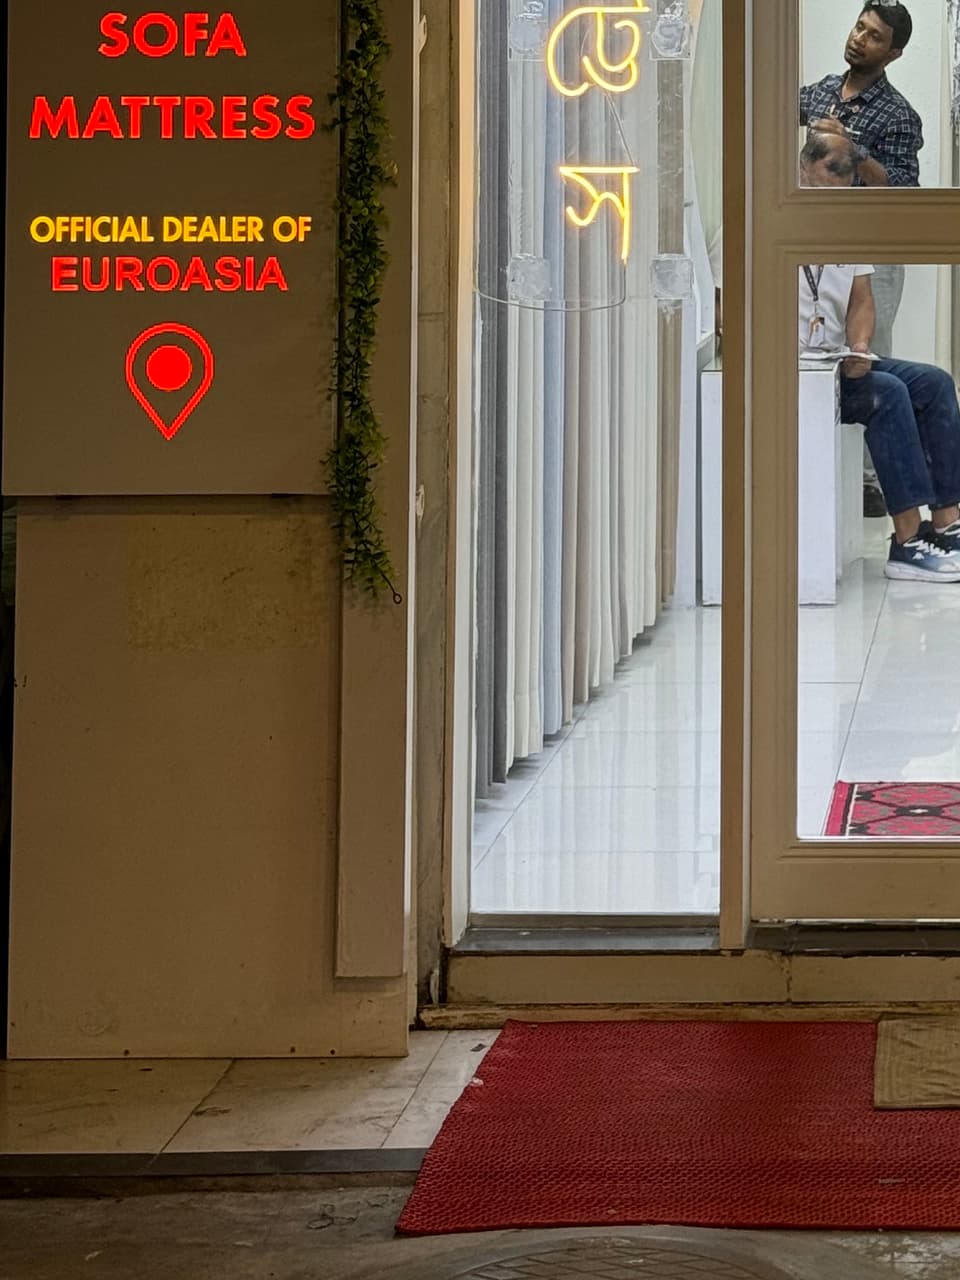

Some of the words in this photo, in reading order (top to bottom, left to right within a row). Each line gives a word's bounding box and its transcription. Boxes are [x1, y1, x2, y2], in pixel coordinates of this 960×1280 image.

[97, 11, 248, 58] SOFA
[28, 94, 316, 140] MATTRESS
[29, 214, 155, 243] OFFICIAL
[162, 215, 264, 242] DEALER
[271, 215, 312, 242] OF
[50, 255, 289, 292] EUROASIA
